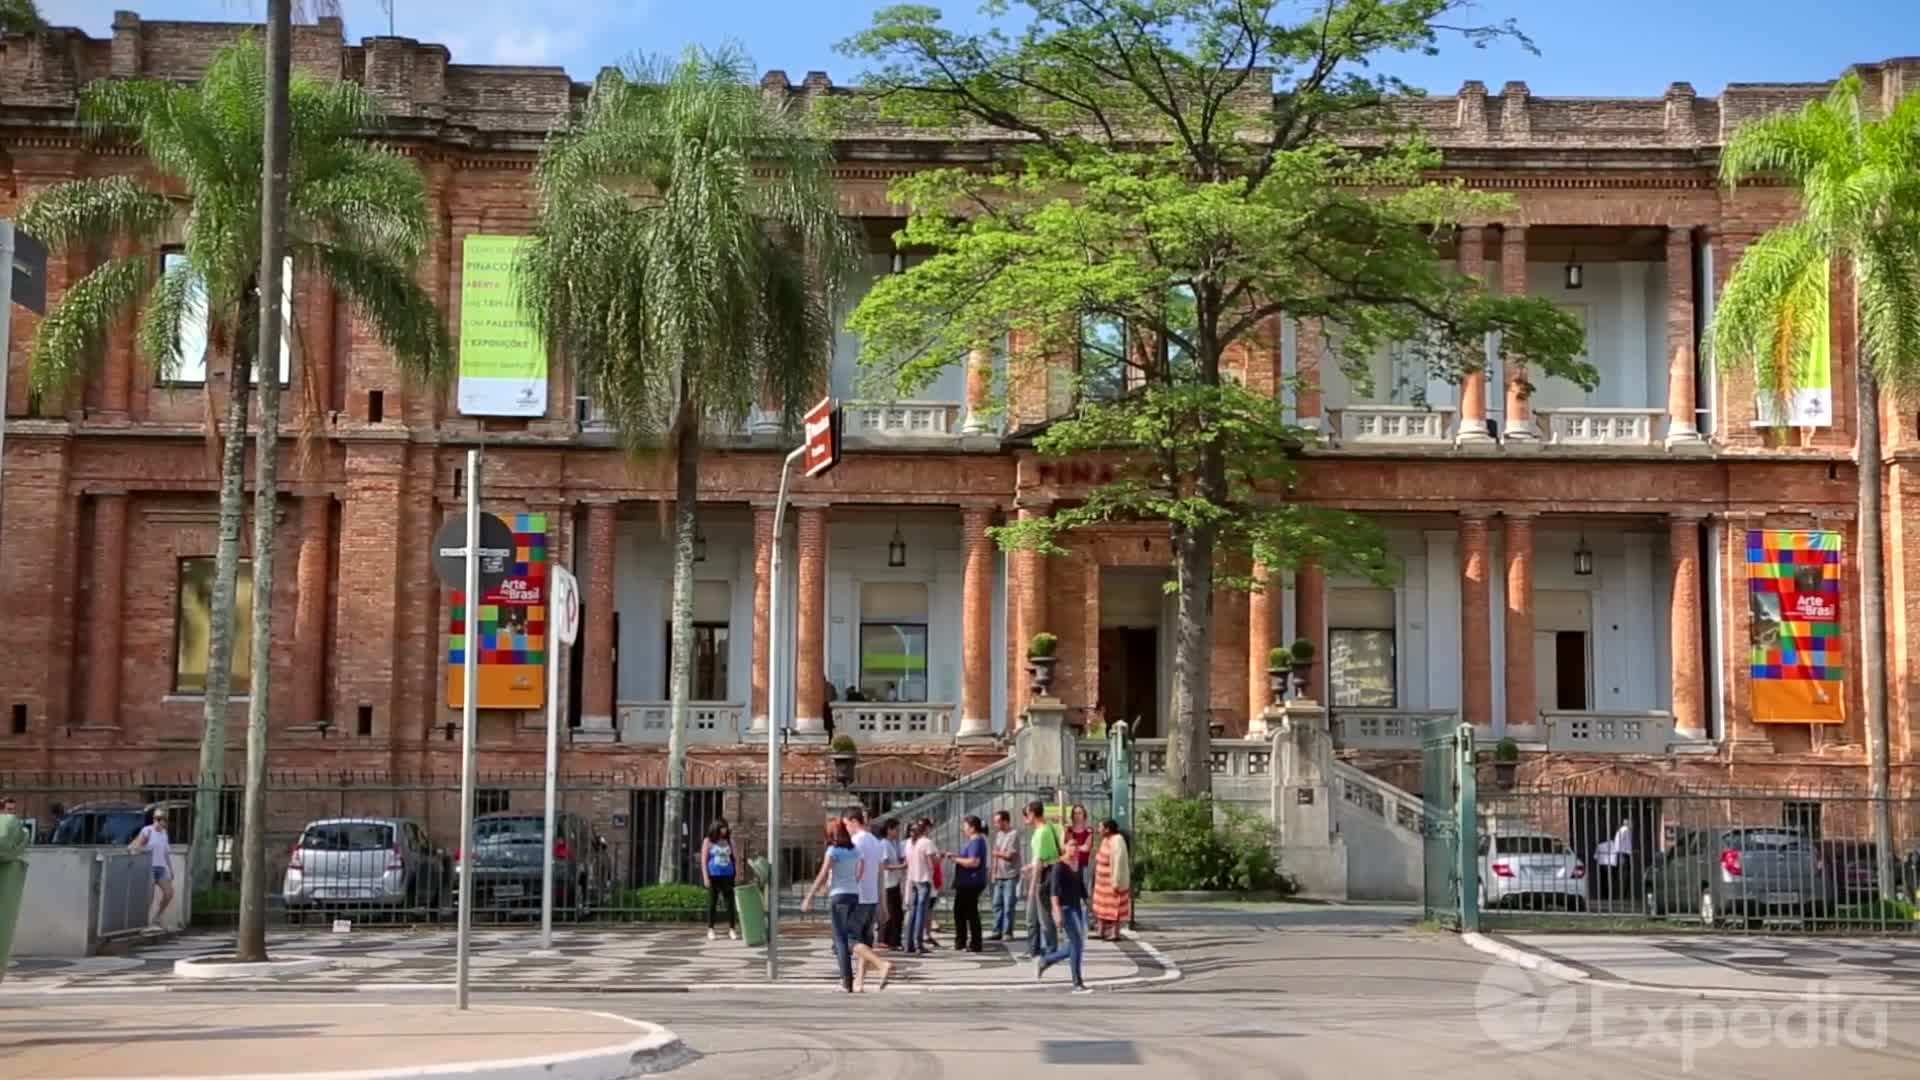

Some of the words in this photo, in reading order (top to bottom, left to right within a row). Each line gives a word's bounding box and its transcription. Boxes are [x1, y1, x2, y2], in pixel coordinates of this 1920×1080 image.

[501, 579, 527, 590] Arte
[509, 587, 540, 600] Brasil
[1797, 595, 1824, 606] Arte
[1805, 603, 1835, 616] Brasil
